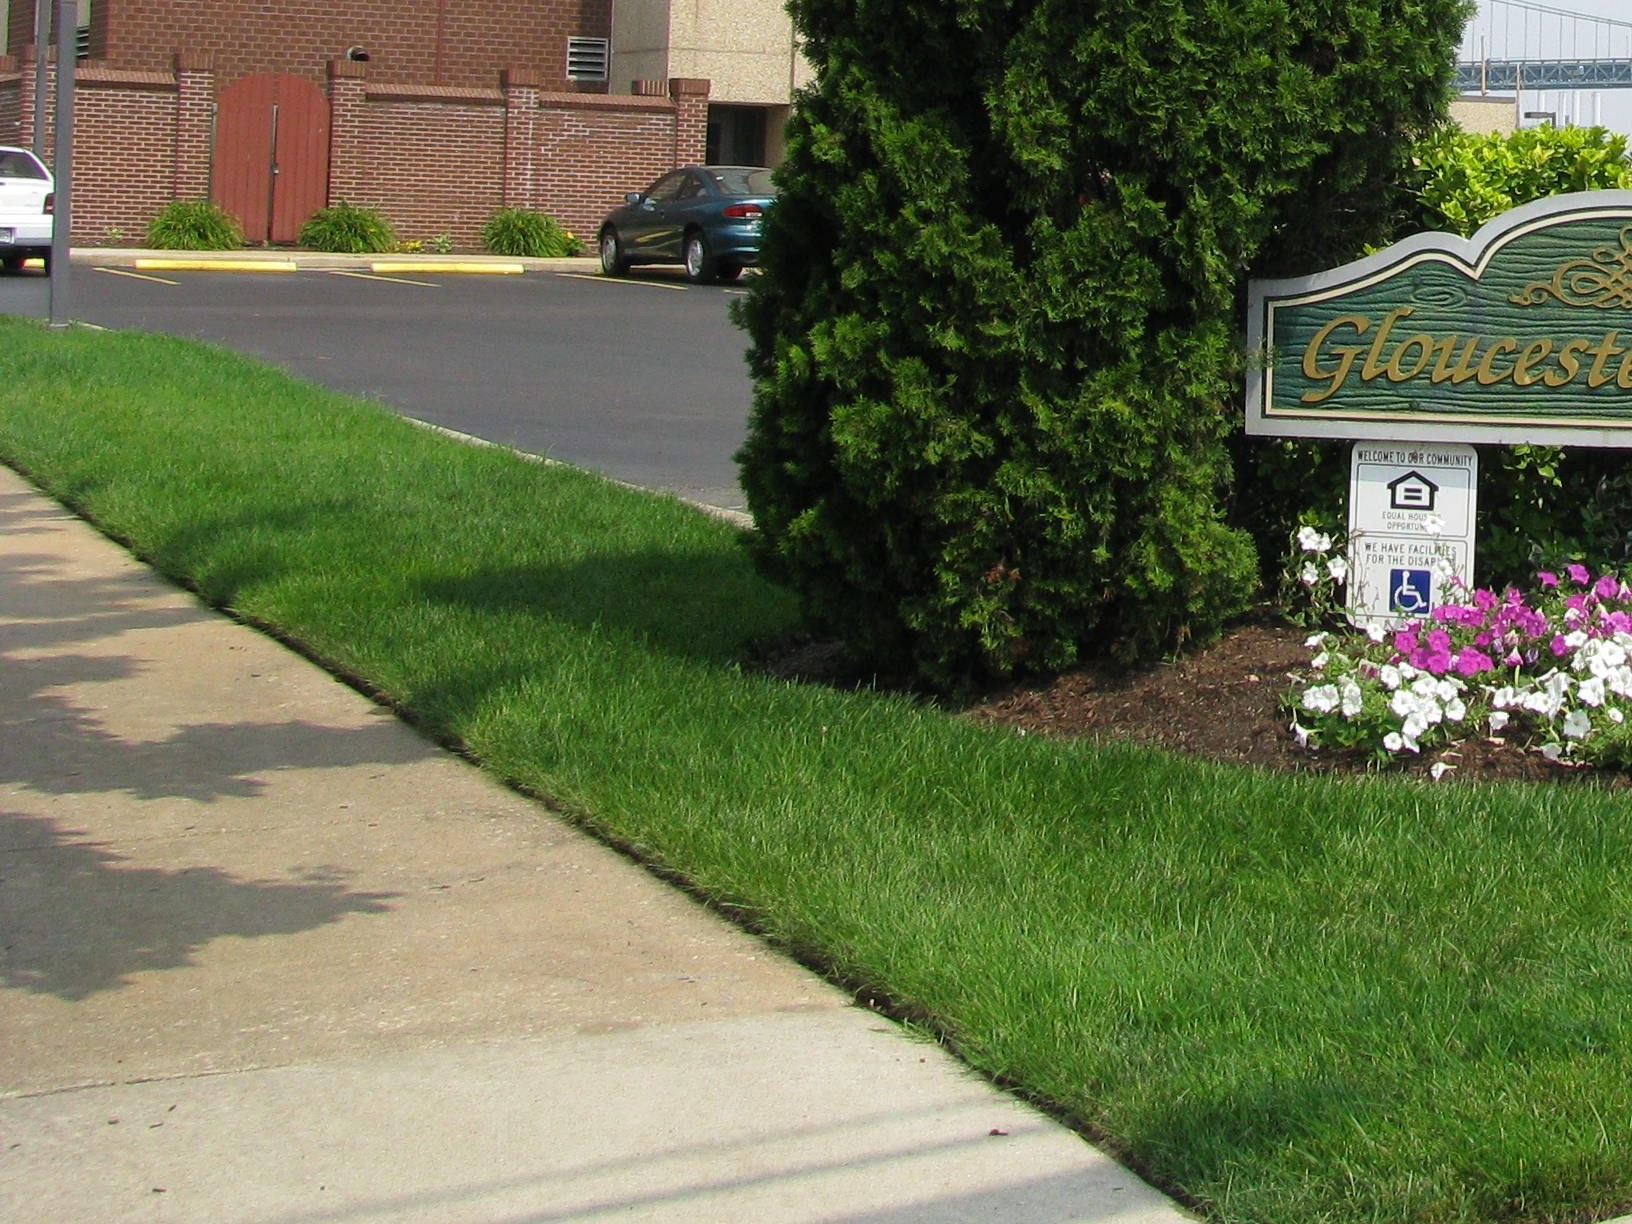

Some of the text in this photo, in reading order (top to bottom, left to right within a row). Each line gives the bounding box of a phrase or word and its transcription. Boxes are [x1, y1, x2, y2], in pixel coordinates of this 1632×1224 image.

[1358, 450, 1473, 466] WELCOME TO OUR COMMUNITY
[1382, 511, 1405, 520] EQUAL
[1387, 522, 1426, 531] OPPORTUN
[1364, 542, 1378, 552] WE
[1381, 543, 1405, 554] HAVE
[1366, 554, 1384, 564] FOR
[1387, 555, 1405, 565] THE
